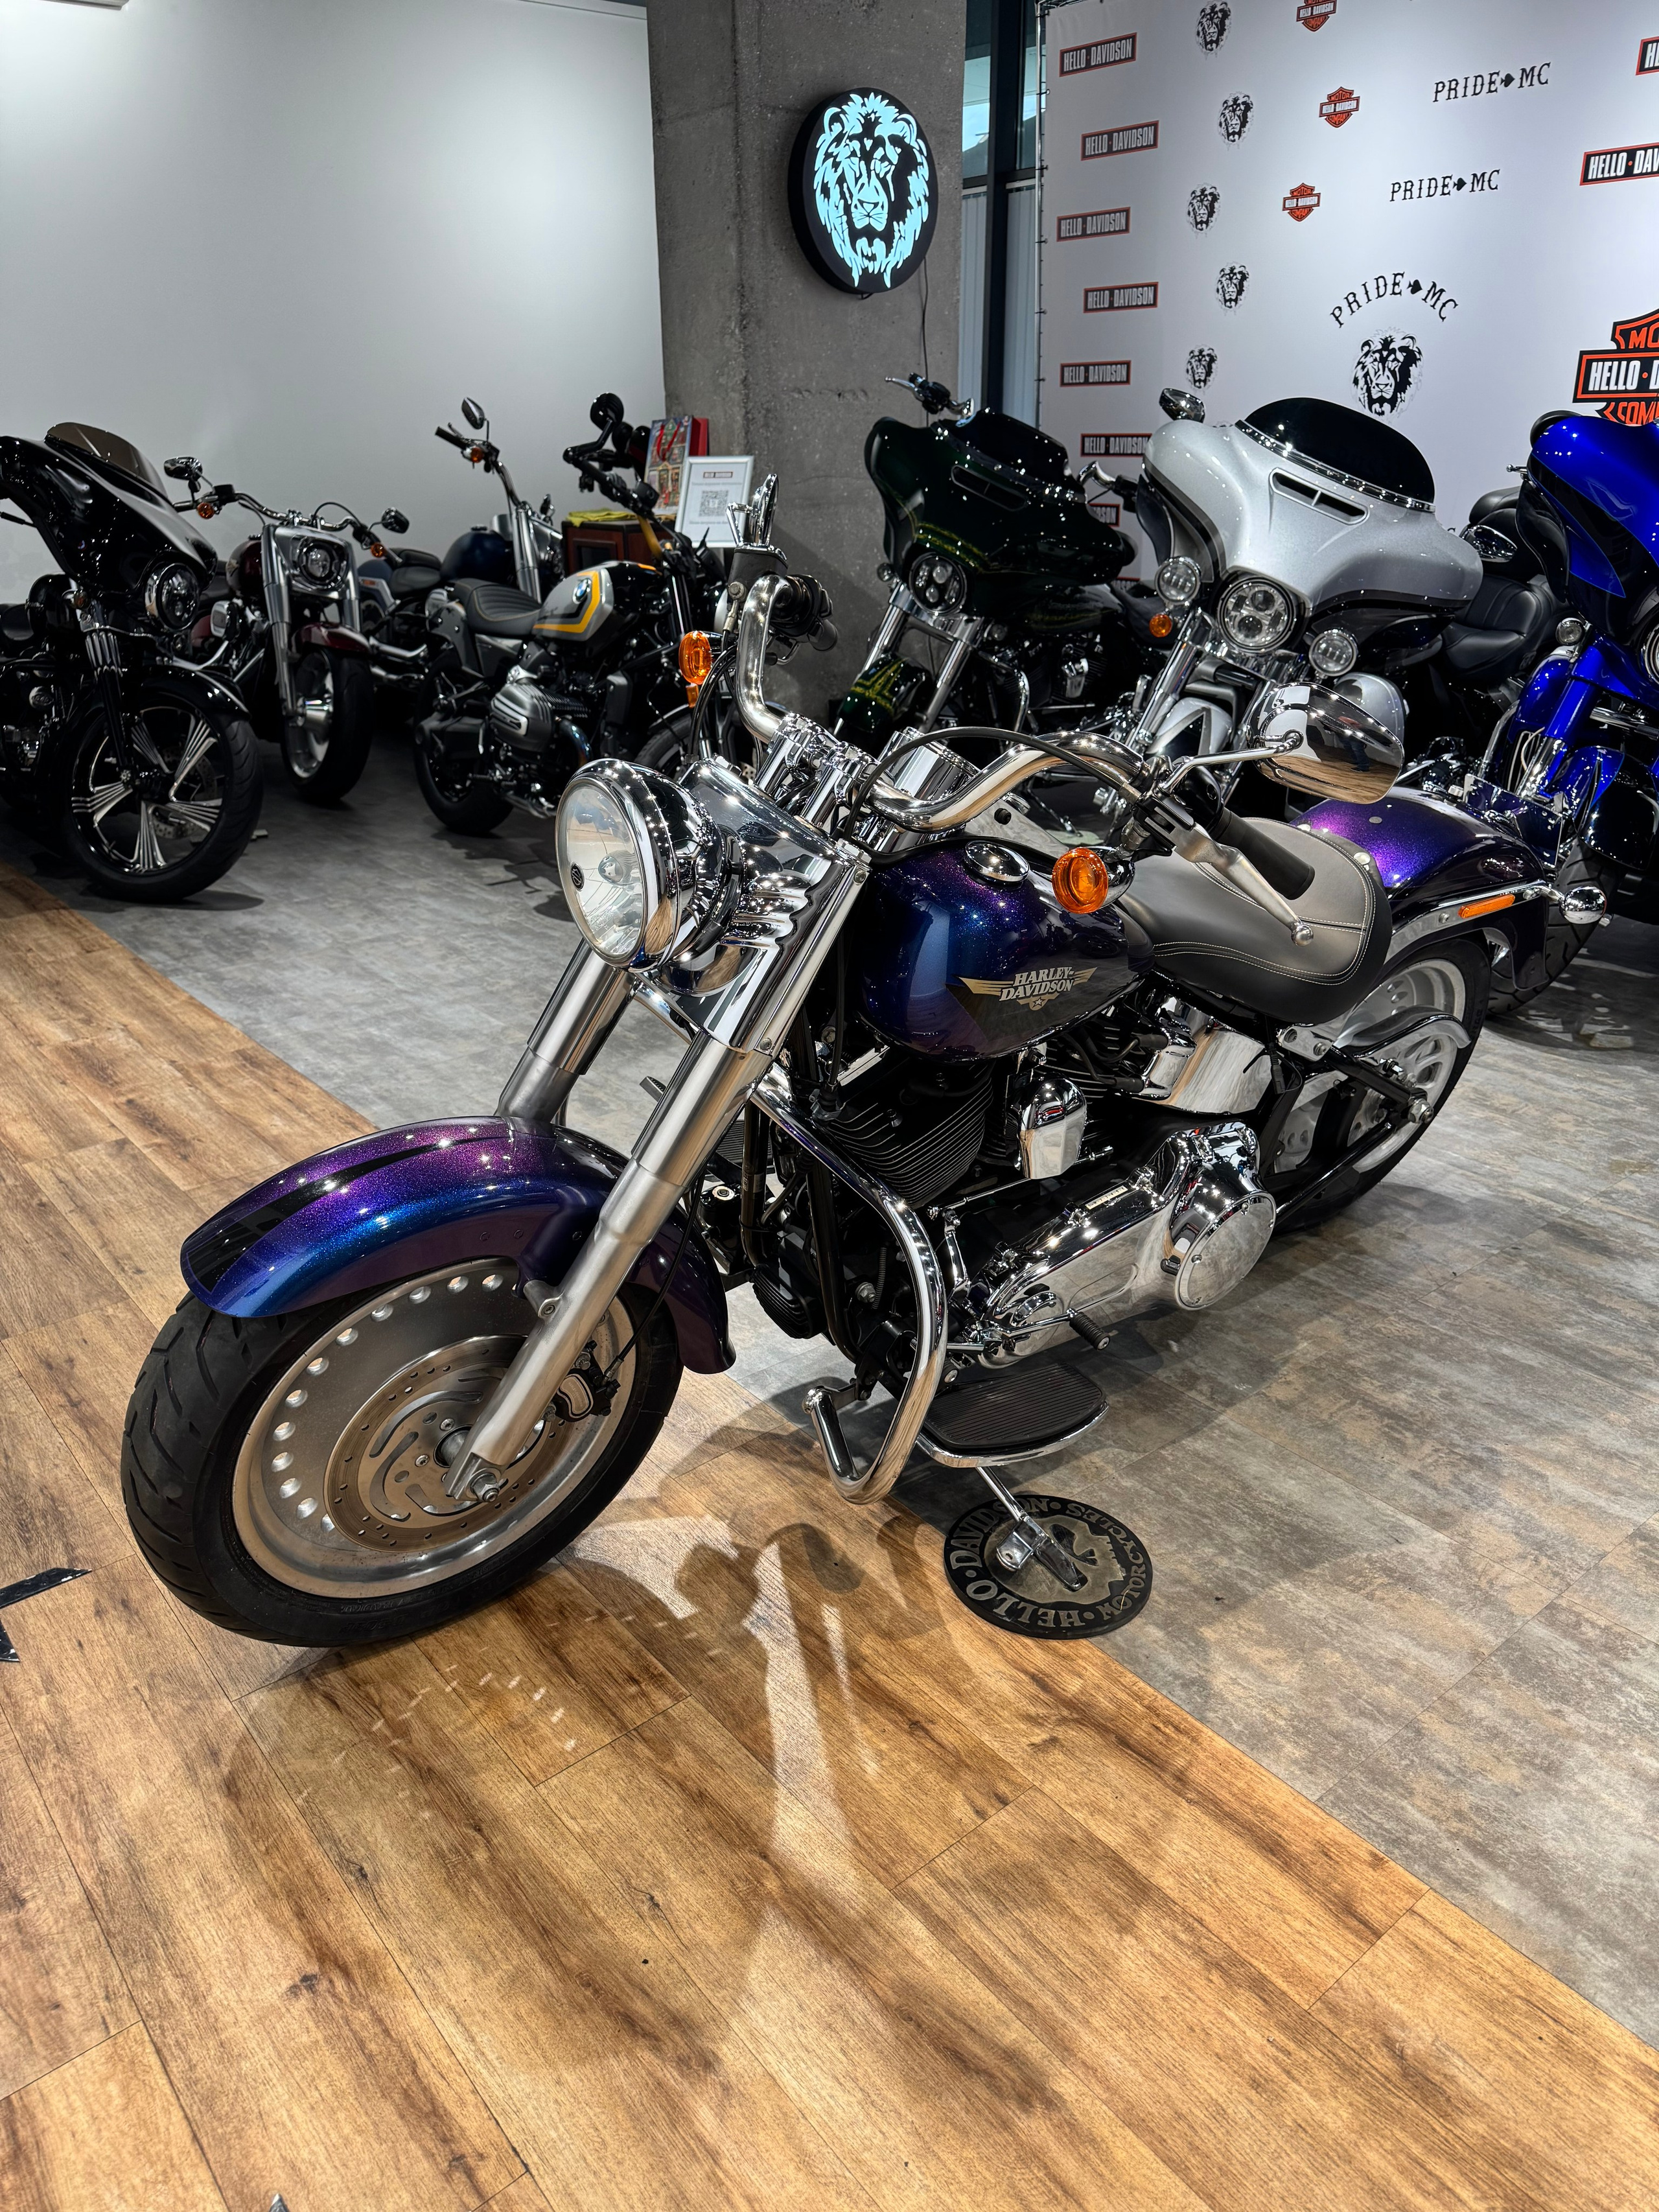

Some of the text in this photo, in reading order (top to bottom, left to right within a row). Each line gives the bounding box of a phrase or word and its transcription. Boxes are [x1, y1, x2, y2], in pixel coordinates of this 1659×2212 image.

[1063, 39, 1132, 71] HELLO DAVIDSON
[1433, 62, 1551, 102] PRIDE MC
[1085, 126, 1154, 156] HELLO DAVIDSON
[1588, 152, 1627, 180] HELLO
[1390, 169, 1500, 202] PRIDE MC
[1060, 212, 1126, 237] HELLO DAVIDSON
[1087, 286, 1154, 309] HELLO DAVIDSON
[1330, 272, 1458, 328] PRIDE MC
[1063, 364, 1126, 383] HELLO DAVIDSON
[1588, 360, 1641, 391] HELLO
[1084, 437, 1105, 454] HELLO
[999, 979, 1074, 1001] DAVIDSON
[1013, 967, 1074, 986] HARLEY-
